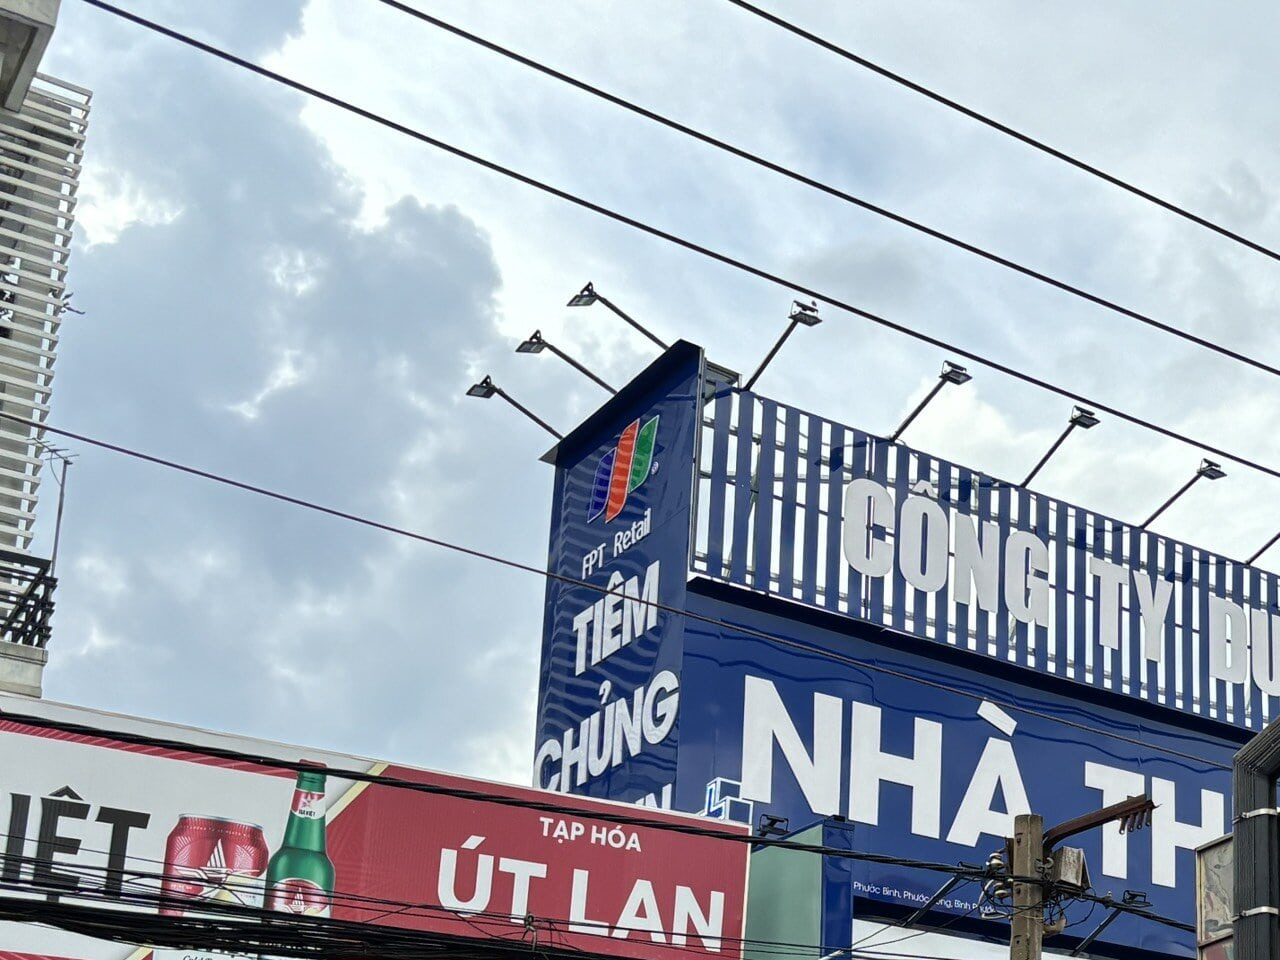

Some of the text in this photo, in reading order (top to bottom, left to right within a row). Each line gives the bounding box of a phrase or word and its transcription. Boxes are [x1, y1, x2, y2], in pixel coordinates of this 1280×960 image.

[582, 508, 652, 580] FPT Retail
[843, 478, 1049, 628] CÔNG
[1091, 556, 1173, 662] TY
[573, 560, 660, 676] TIÊM
[533, 670, 680, 793] CHỦNG
[739, 675, 1035, 848] NHÀ
[539, 816, 641, 852] TẠP HÓA
[853, 881, 881, 895] Phước
[437, 835, 725, 953] ÚT LAN
